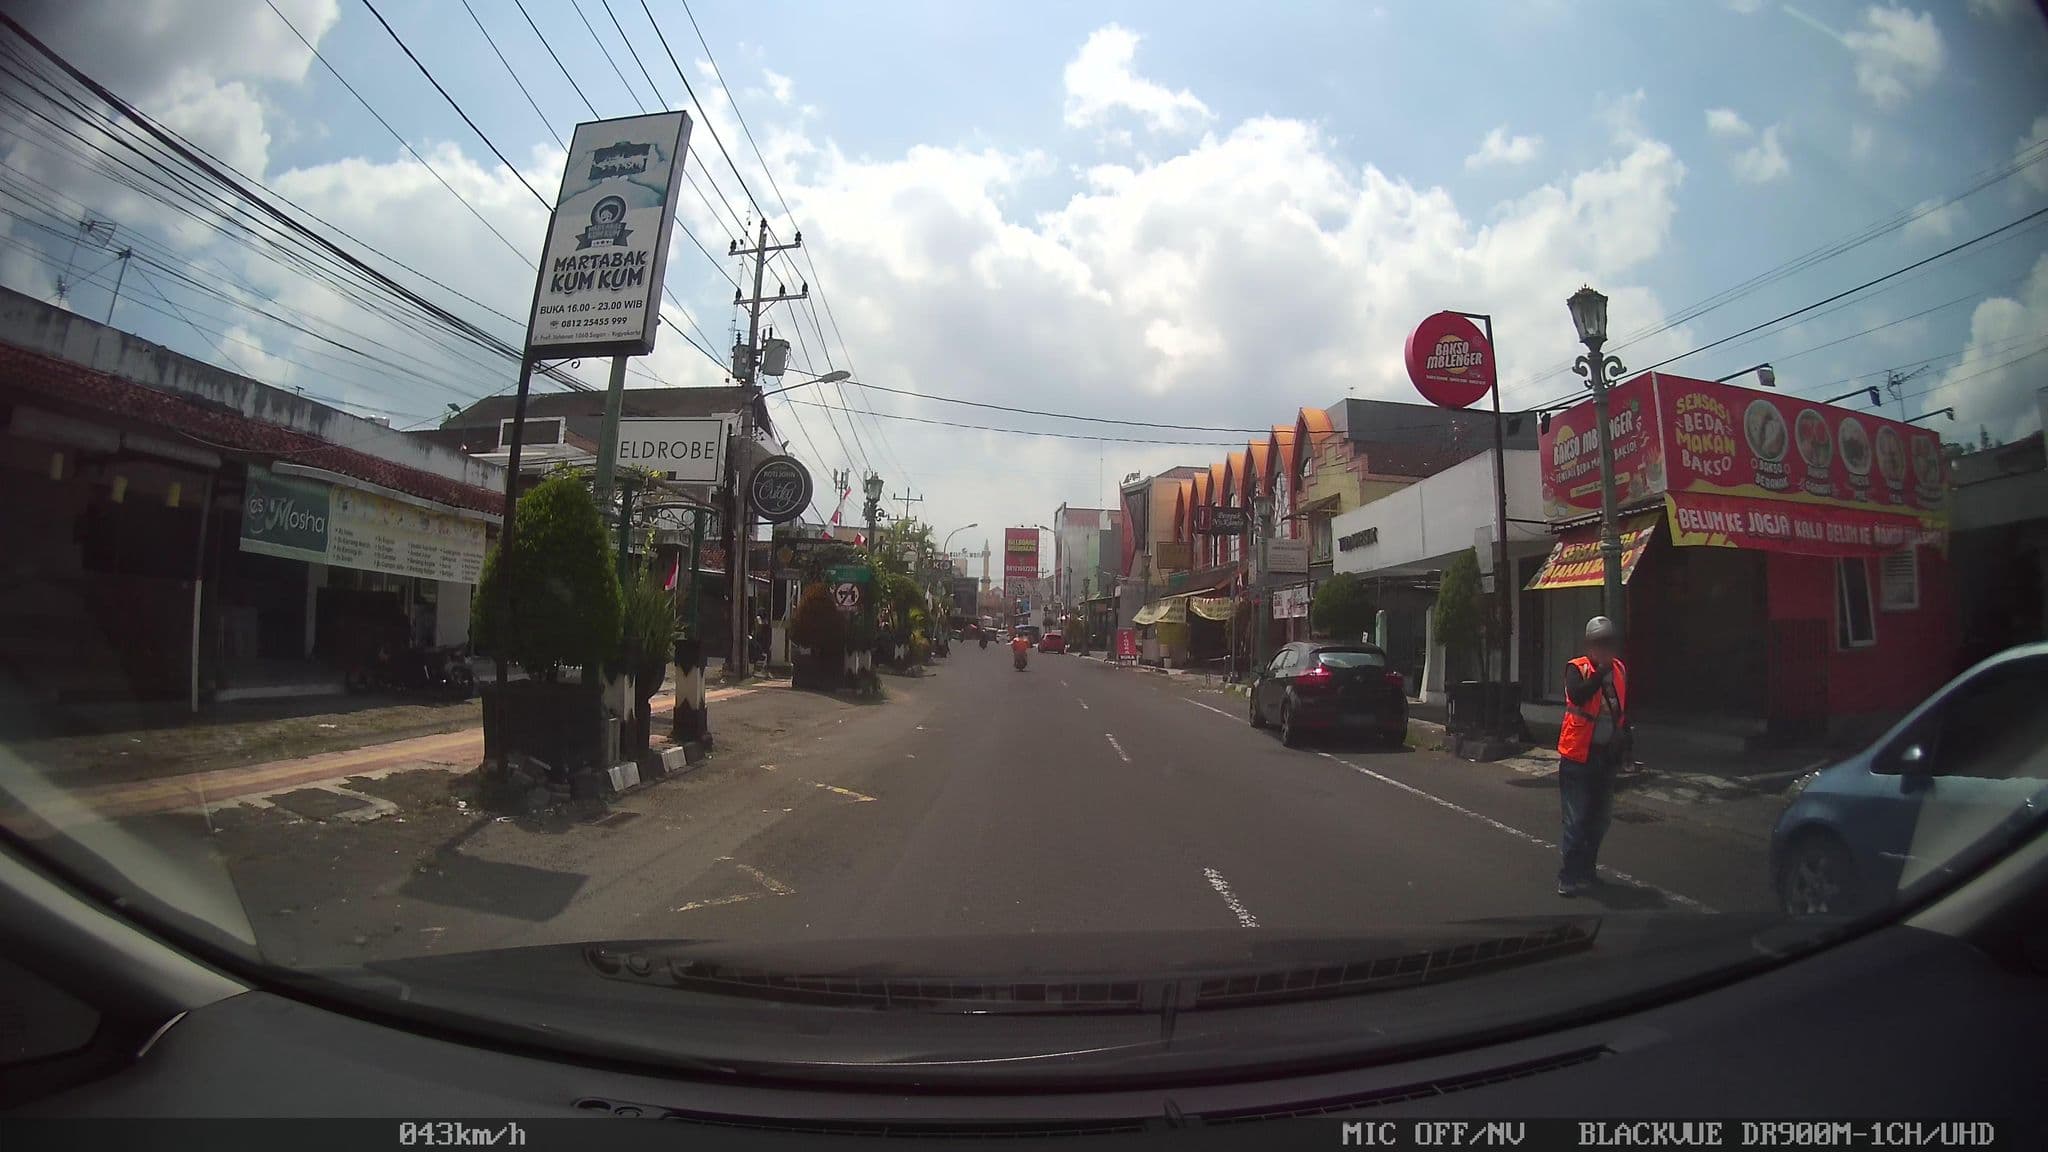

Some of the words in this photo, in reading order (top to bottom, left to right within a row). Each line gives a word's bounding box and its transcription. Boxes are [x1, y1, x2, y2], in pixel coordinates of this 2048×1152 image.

[553, 250, 647, 272] MARTABAK
[550, 271, 595, 294] KUM
[598, 266, 645, 291] KUM
[540, 304, 565, 315] BUKA
[567, 303, 590, 313] 16.00
[598, 301, 622, 311] 23.00
[624, 299, 643, 309] WIB
[561, 319, 582, 328] 0812
[611, 316, 628, 325] 999
[1426, 352, 1483, 370] MBLENGER
[1435, 341, 1470, 356] BAKSO
[1676, 392, 1731, 425] SENSASI
[1683, 412, 1725, 435] BEDA
[1553, 436, 1580, 466] BAKSO
[1675, 427, 1736, 457] MAKAN
[1681, 448, 1732, 476] BAKSO
[266, 496, 326, 534] Mosha
[1678, 507, 1725, 531] BELUM
[1725, 512, 1744, 533] KE
[1748, 511, 1791, 534] JOGJA
[1794, 519, 1824, 539] KALO
